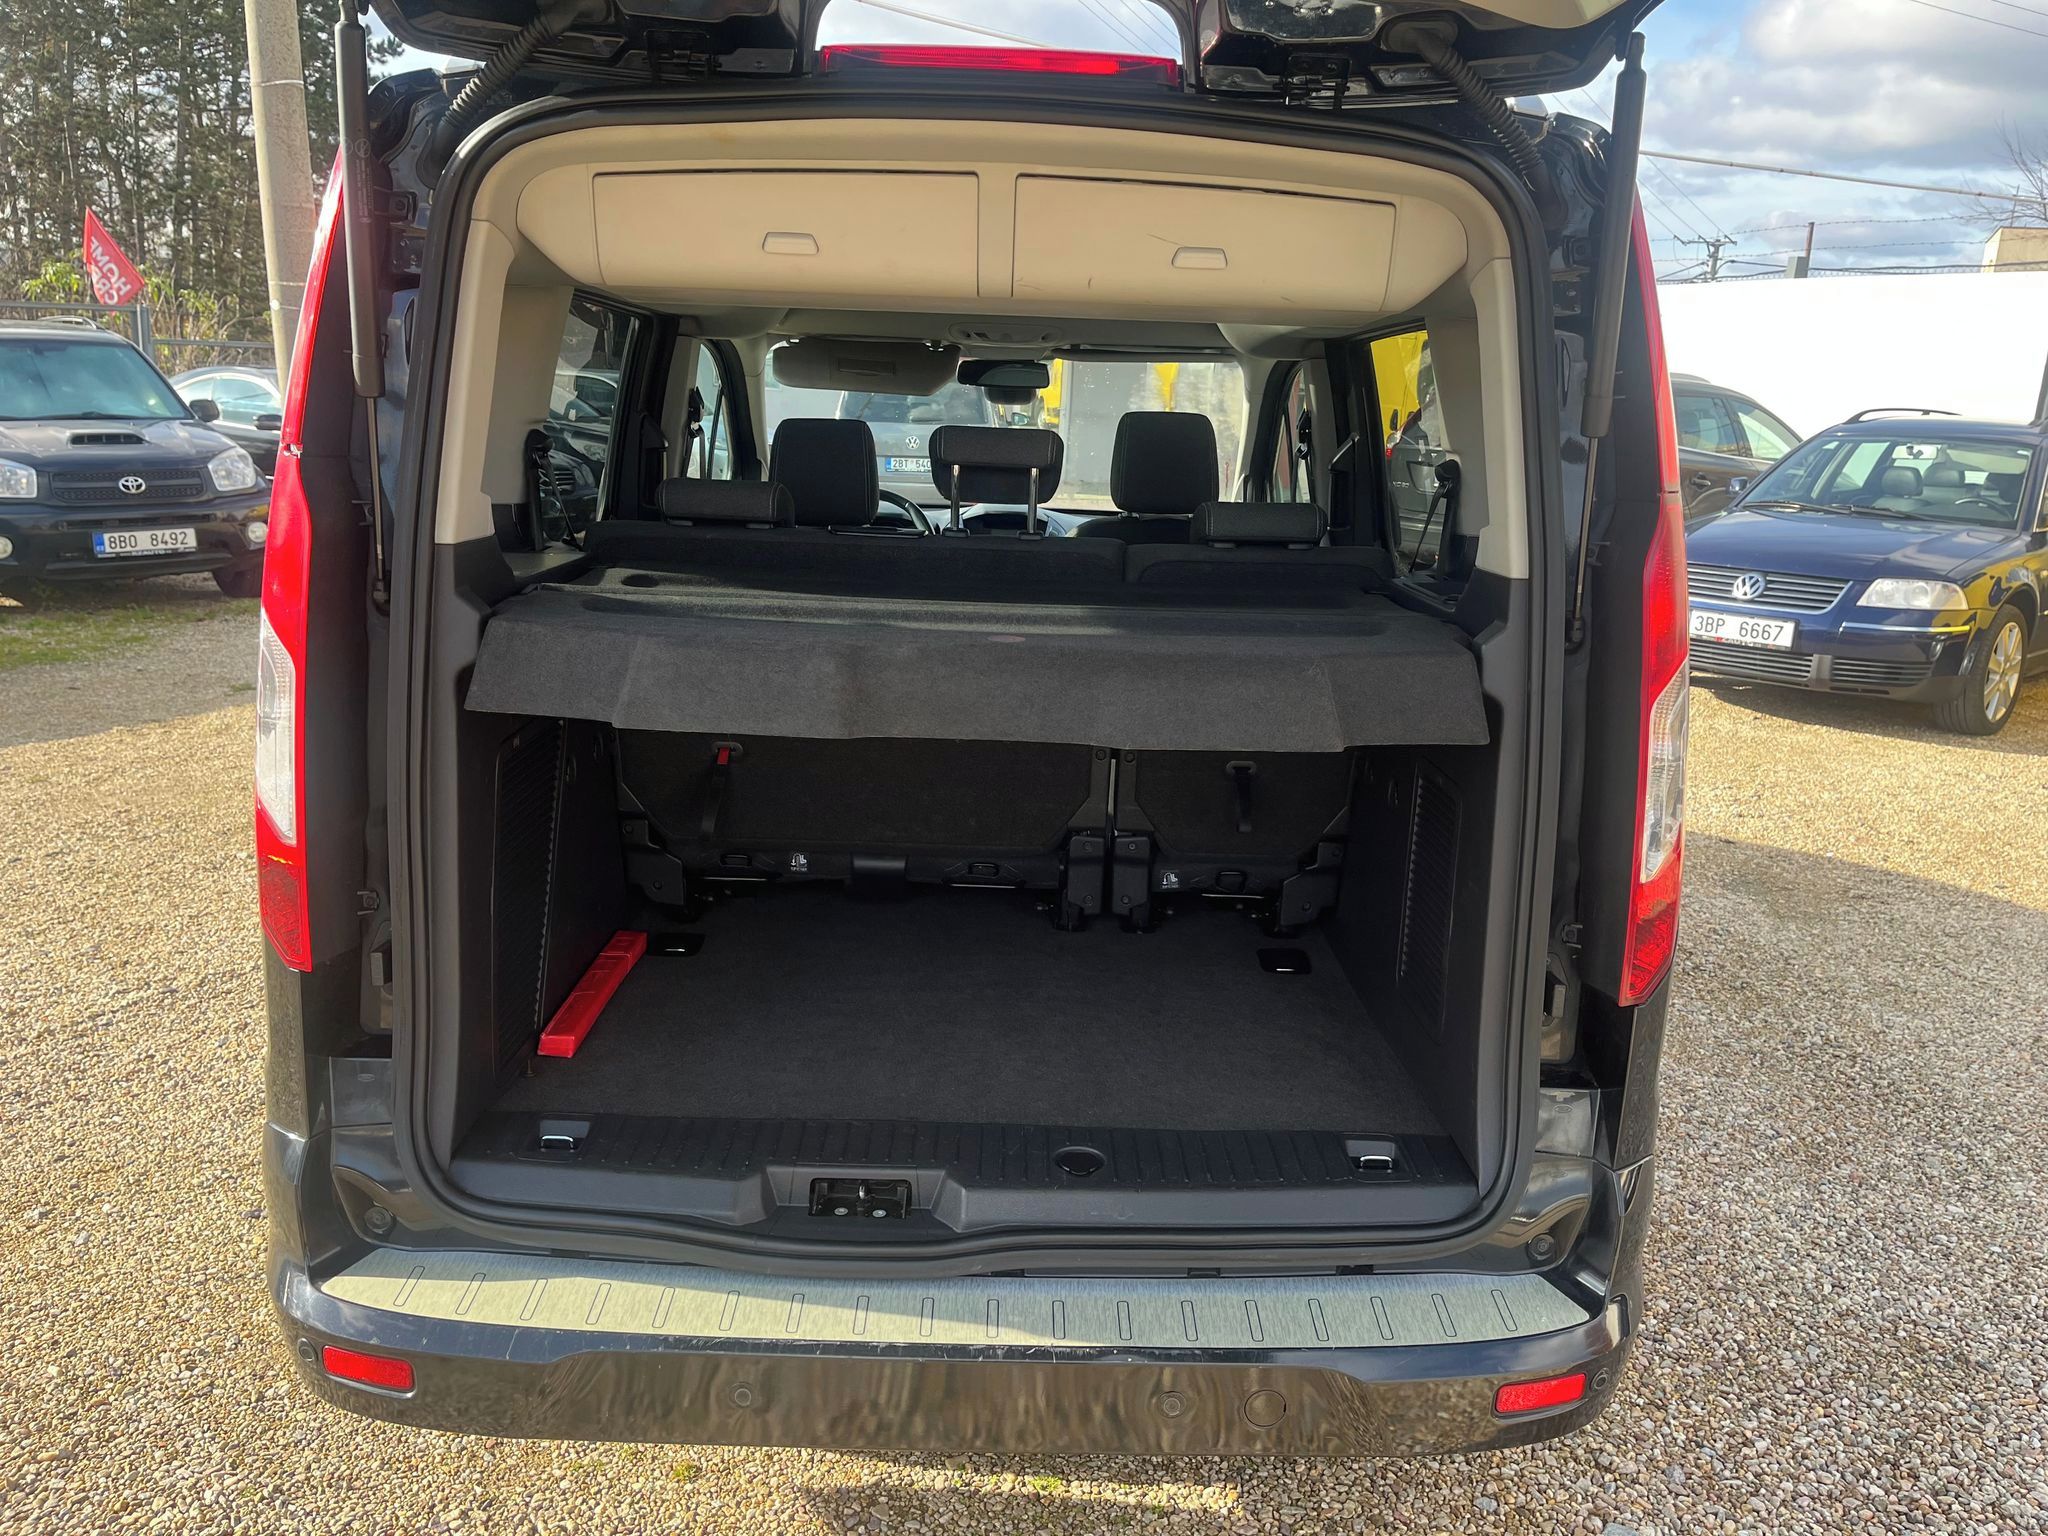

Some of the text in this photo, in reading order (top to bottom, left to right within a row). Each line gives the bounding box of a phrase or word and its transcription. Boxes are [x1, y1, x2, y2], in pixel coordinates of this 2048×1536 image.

[893, 459, 908, 468] 2BT
[150, 531, 188, 547] 8492
[1694, 615, 1784, 642] 3BP 6667
